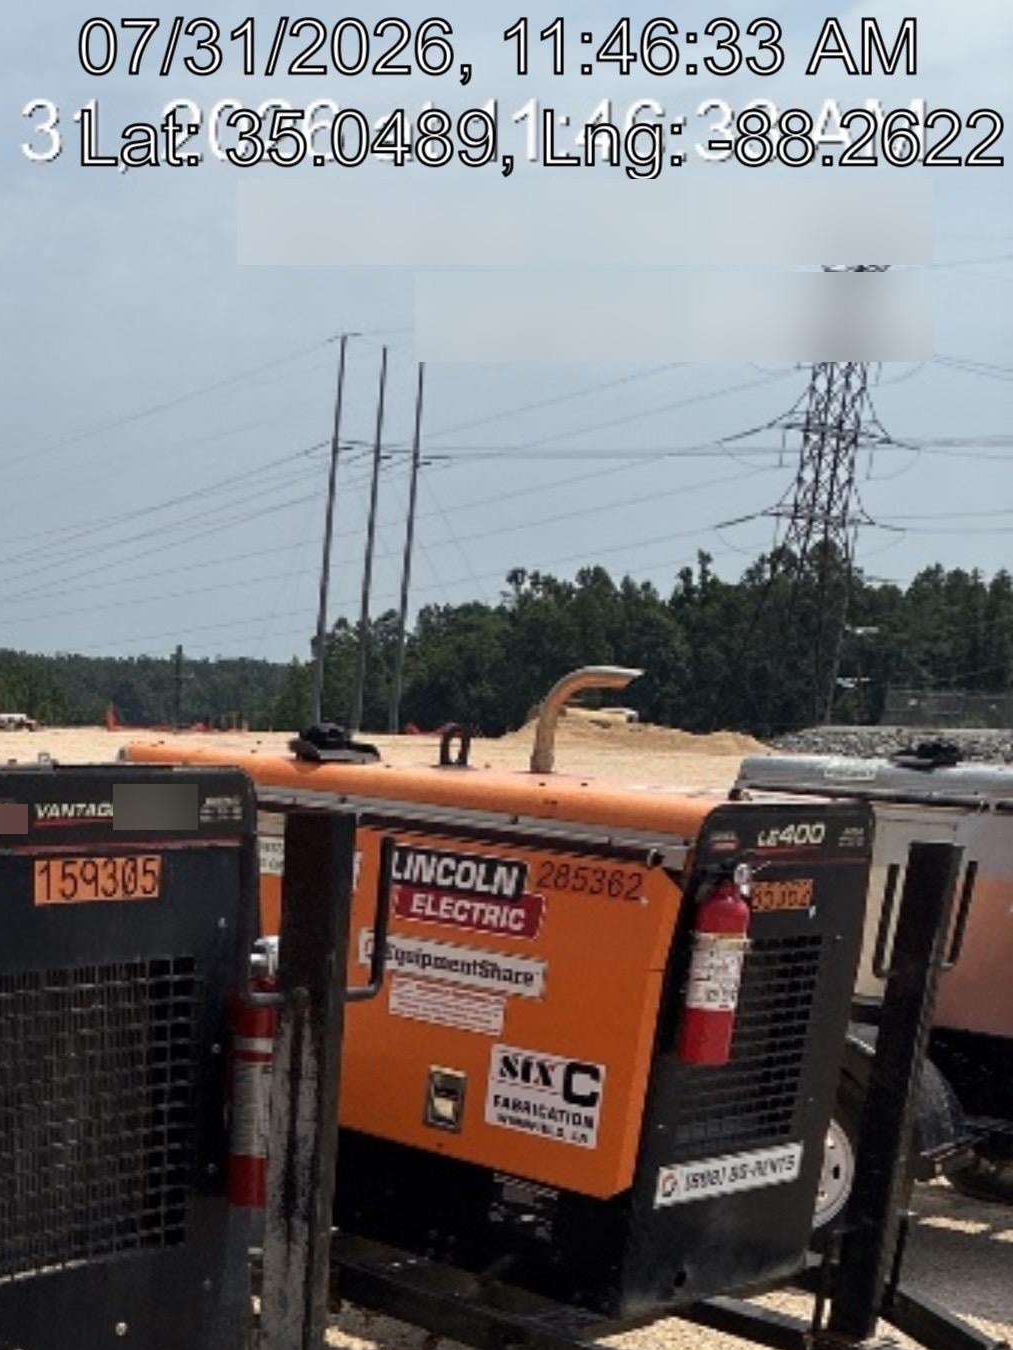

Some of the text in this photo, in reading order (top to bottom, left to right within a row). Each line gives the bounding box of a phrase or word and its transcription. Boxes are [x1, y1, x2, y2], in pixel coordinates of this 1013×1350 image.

[34, 802, 114, 819] VANTAG
[37, 857, 159, 901] 159305
[391, 850, 519, 897] LINCOLN
[537, 859, 644, 900] 285362
[409, 893, 525, 931] ELECTRIC
[386, 943, 535, 987] EquipmentShare
[562, 1062, 600, 1107] C
[493, 1094, 594, 1129] FABRICATION
